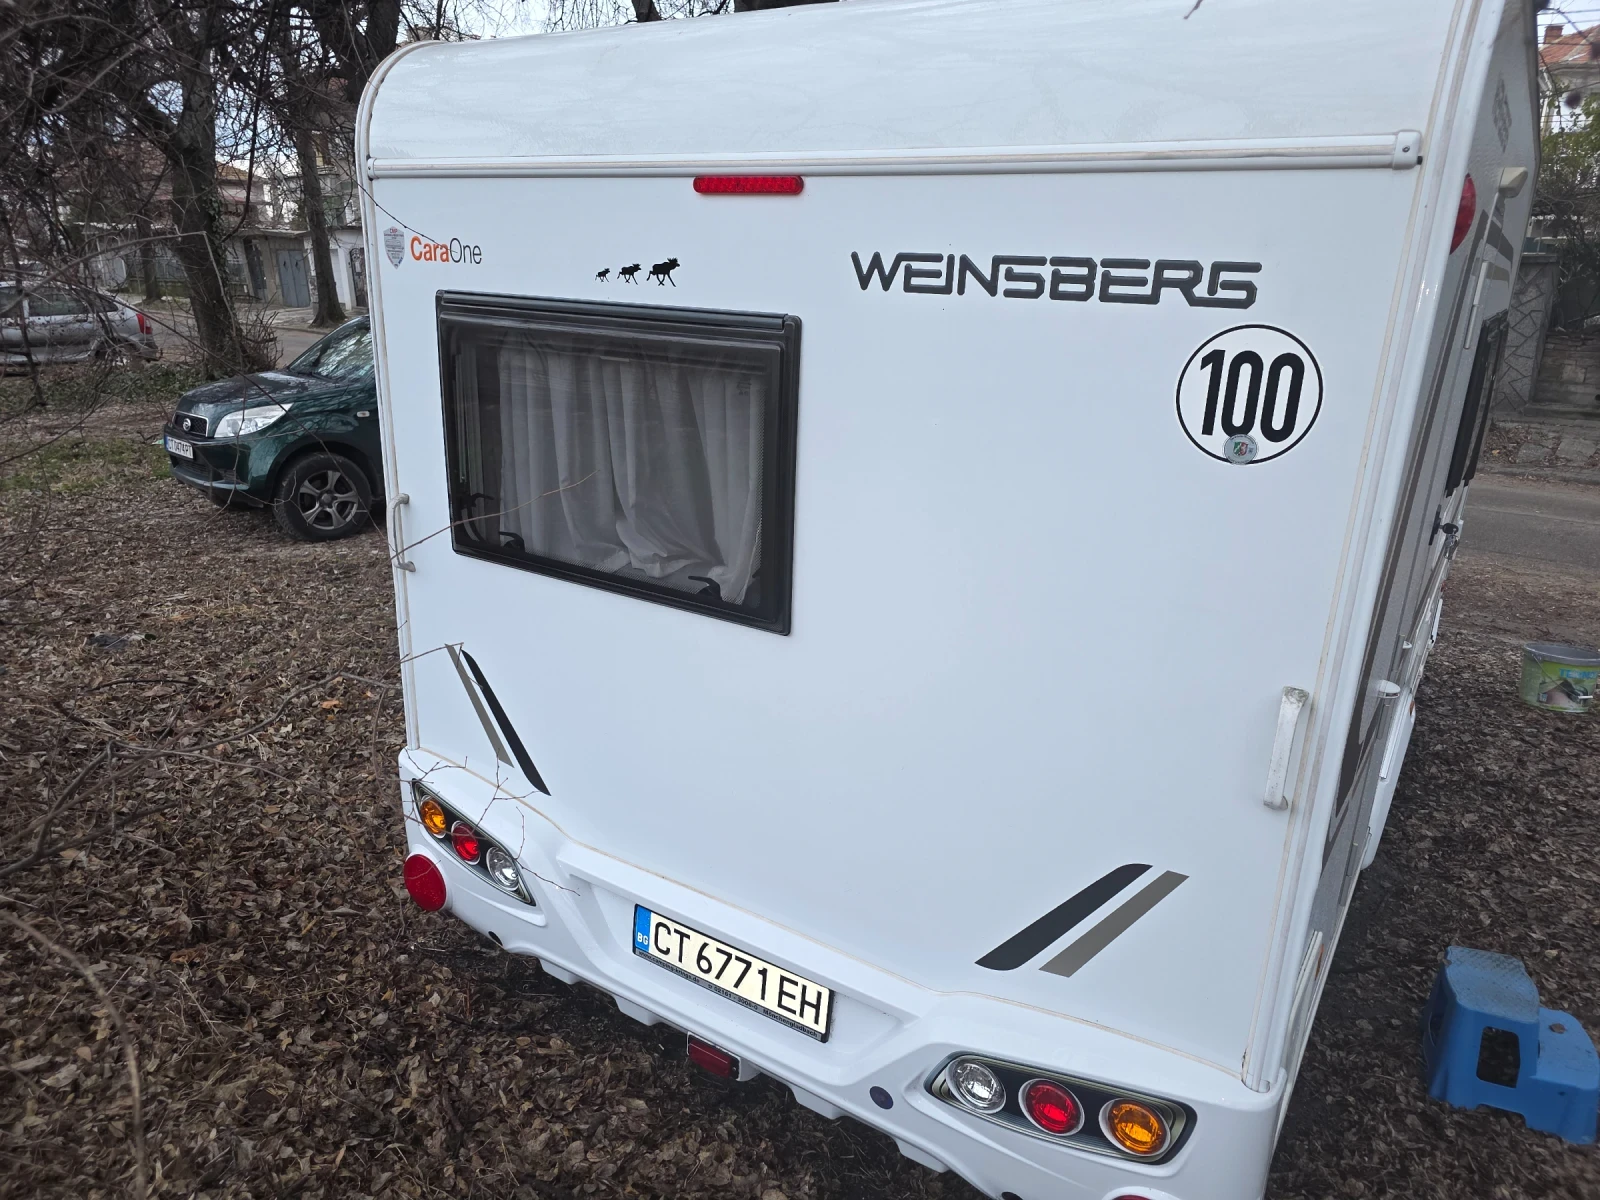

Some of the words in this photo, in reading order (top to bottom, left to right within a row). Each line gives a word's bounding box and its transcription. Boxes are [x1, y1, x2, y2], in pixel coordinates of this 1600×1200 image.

[410, 236, 482, 265] CaraOne
[850, 251, 1263, 310] WEINSBERG
[1199, 349, 1306, 444] 100
[637, 931, 649, 946] BG
